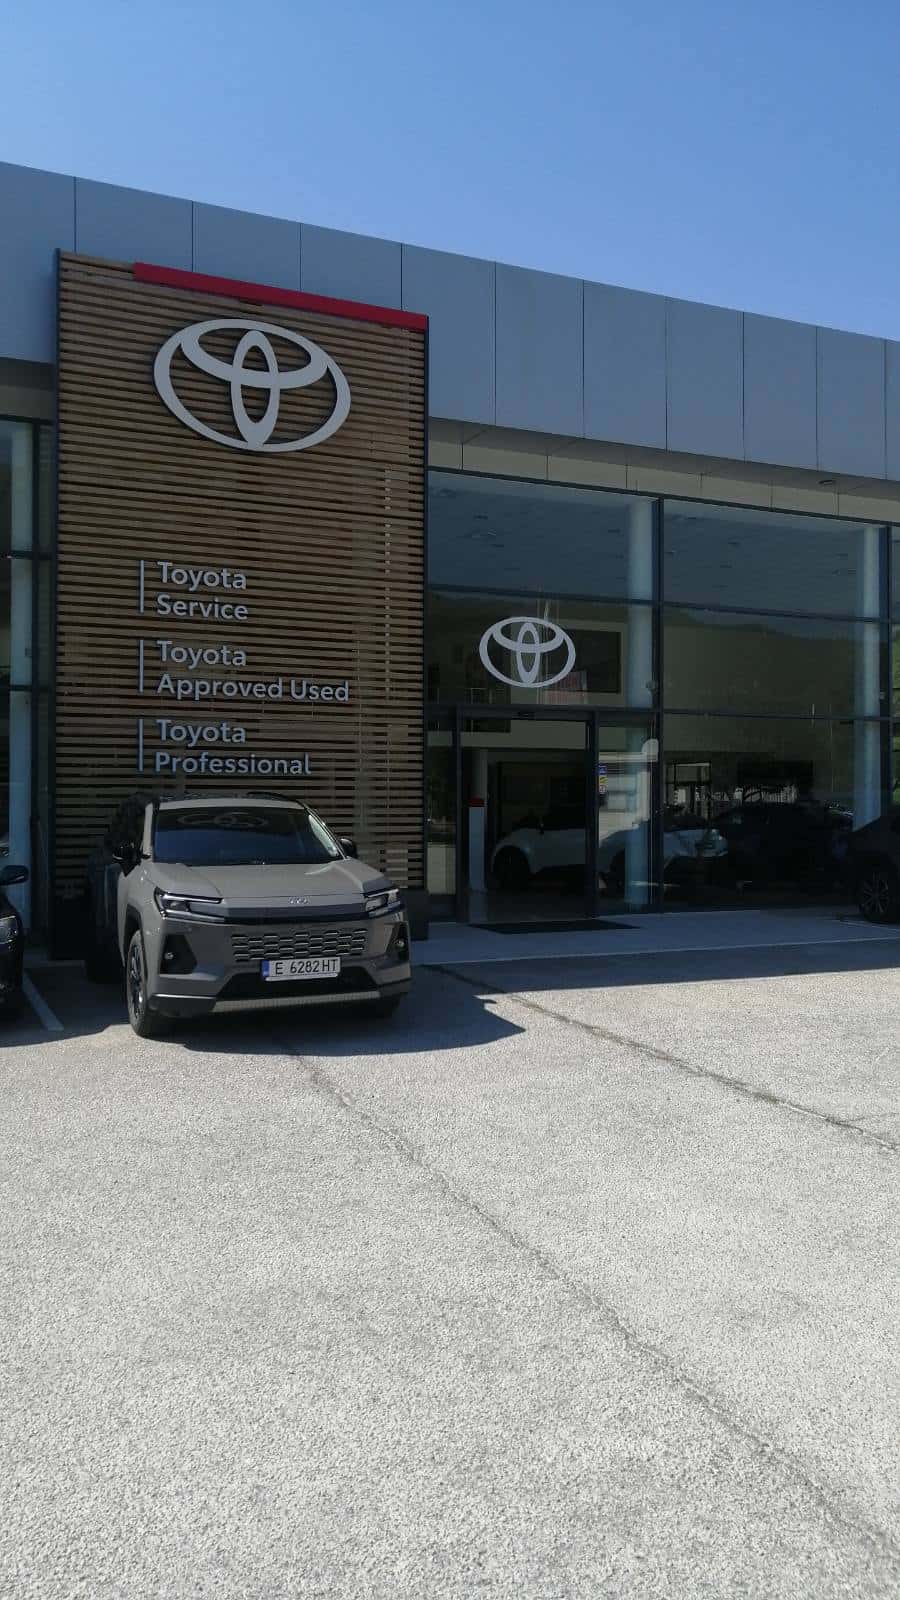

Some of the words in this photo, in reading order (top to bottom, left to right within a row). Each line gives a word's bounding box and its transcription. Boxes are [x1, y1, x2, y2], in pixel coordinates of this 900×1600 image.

[157, 560, 248, 592] Toyota
[156, 593, 249, 620] Service
[156, 640, 248, 670] Toyota
[156, 673, 284, 701] Approved
[290, 679, 350, 701] Used
[155, 718, 247, 747] Toyota
[155, 751, 312, 775] Professional
